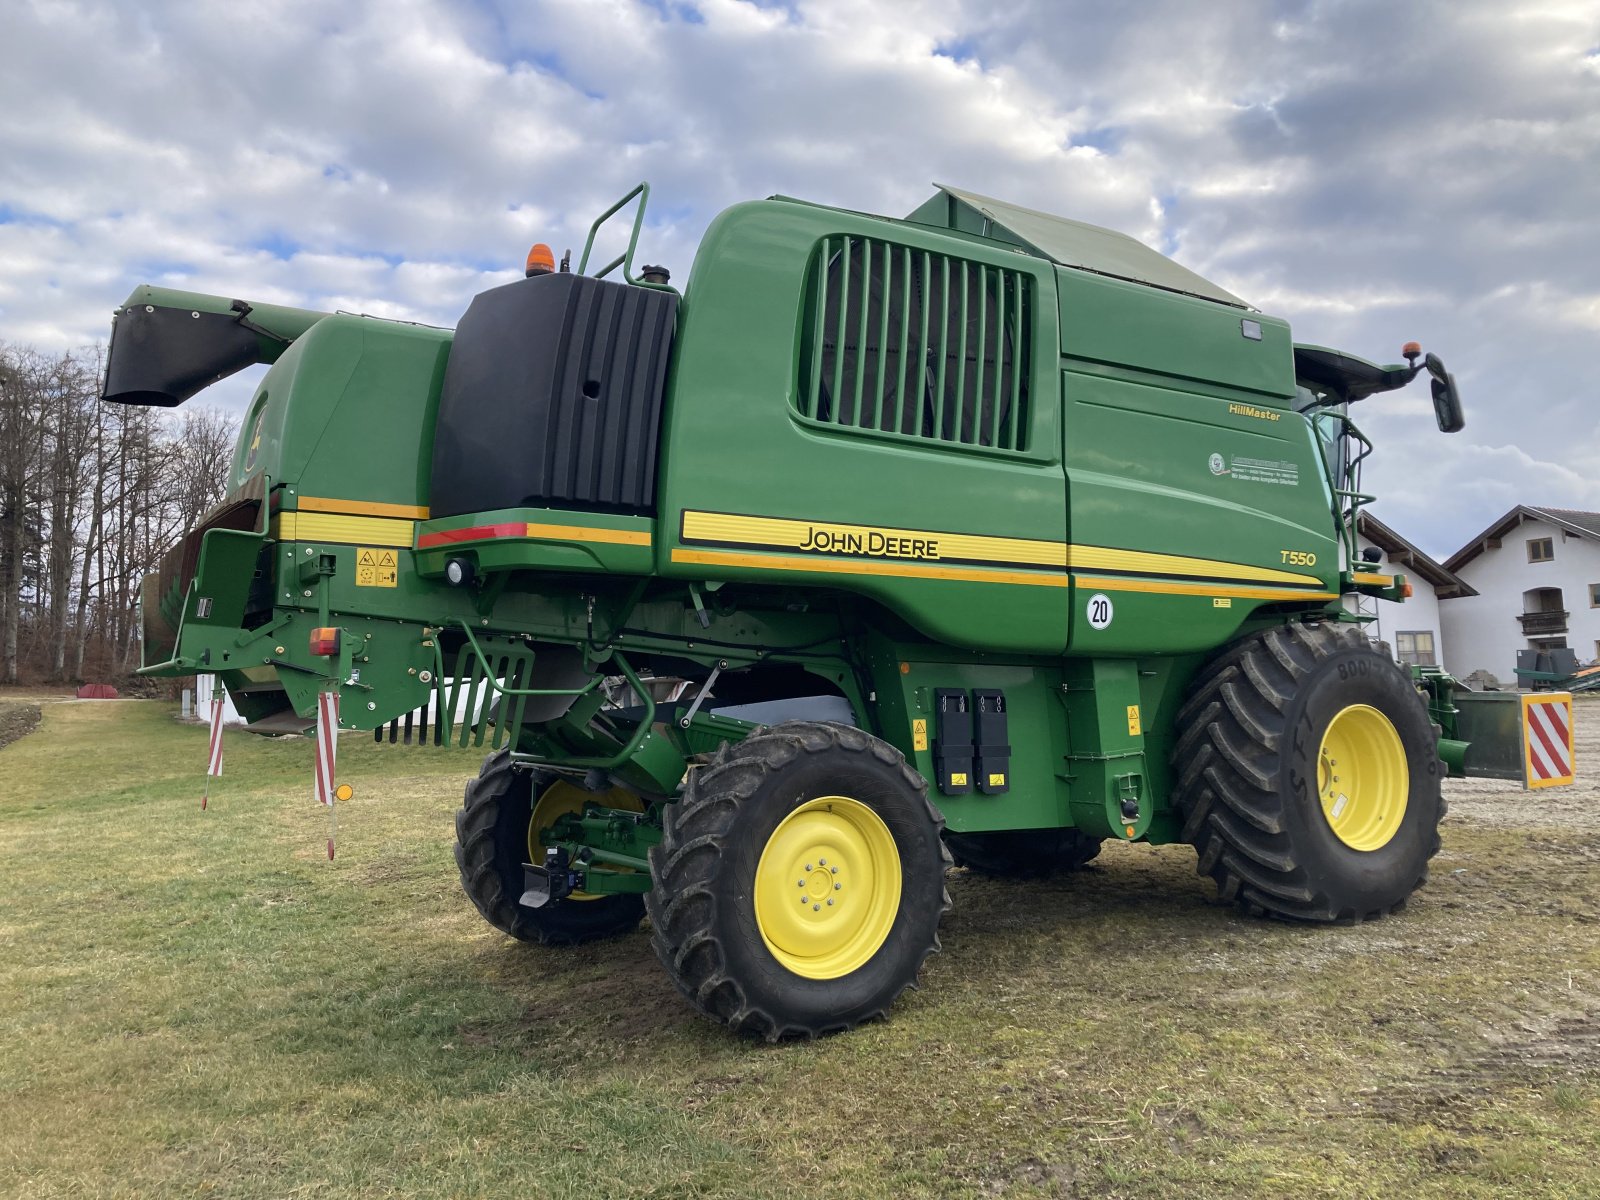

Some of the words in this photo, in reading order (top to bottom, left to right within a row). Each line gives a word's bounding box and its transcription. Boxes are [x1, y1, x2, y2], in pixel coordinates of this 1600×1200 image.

[1229, 403, 1280, 421] HillMaster
[800, 526, 862, 552] JOHN
[868, 532, 939, 557] DEERE
[1280, 550, 1316, 567] T550
[1092, 600, 1108, 623] 20
